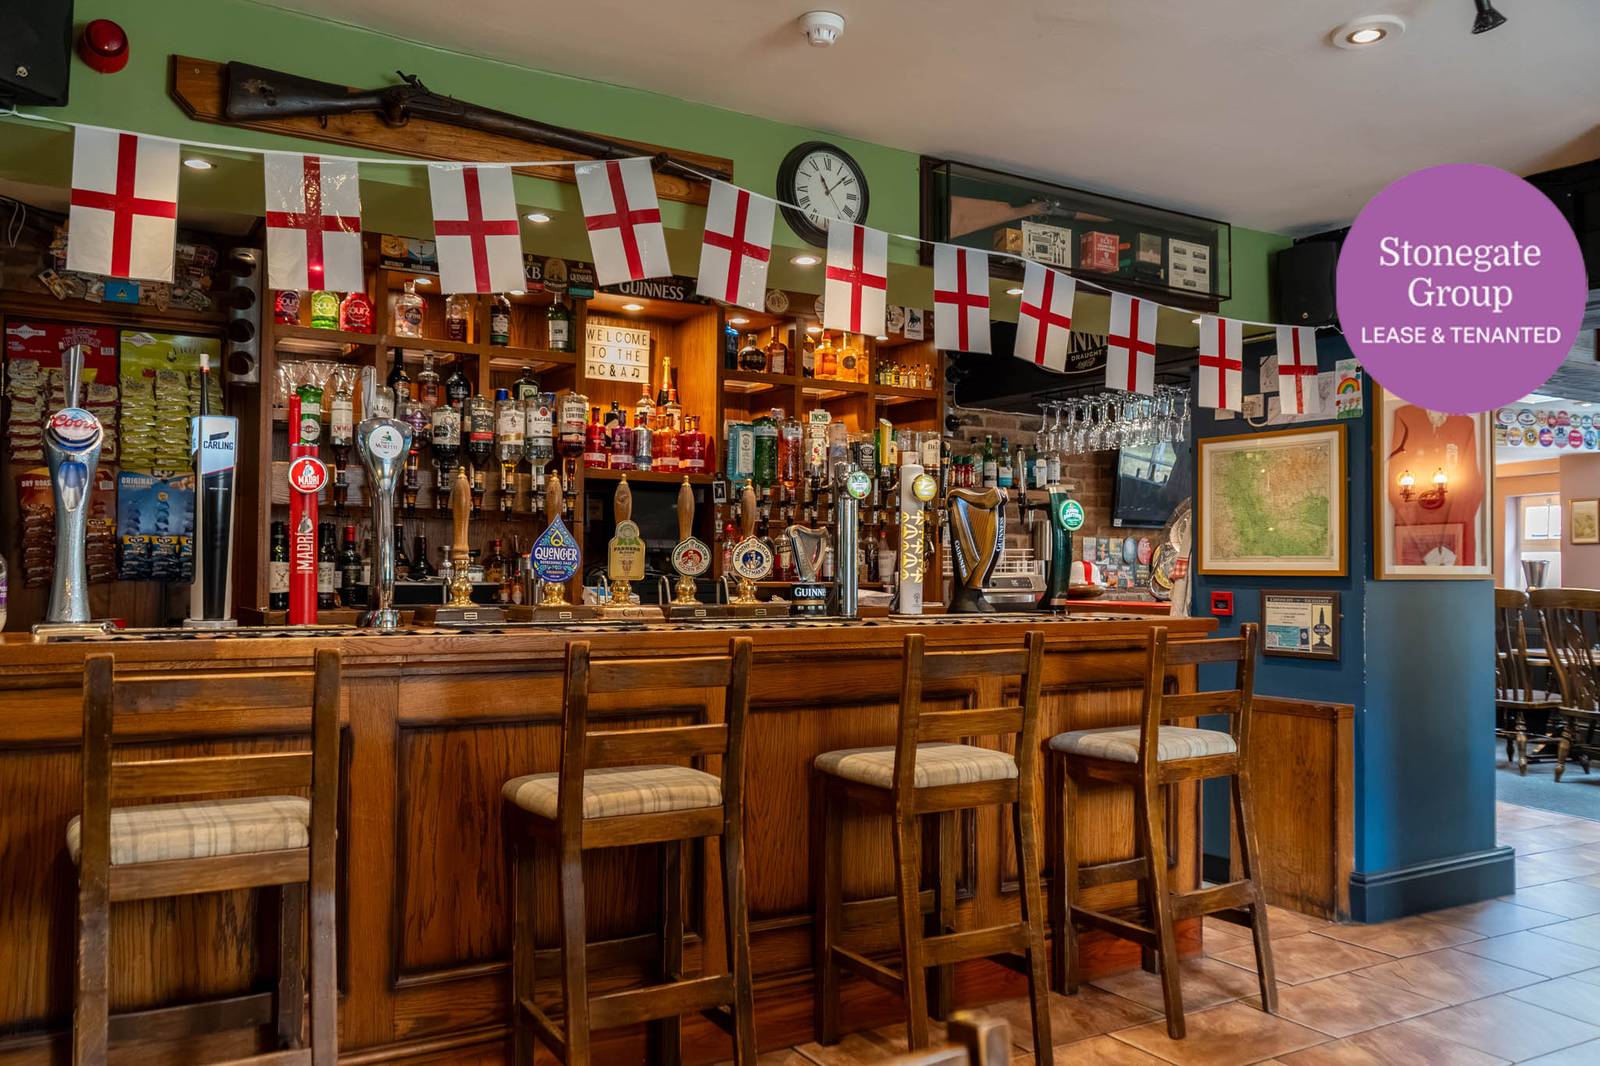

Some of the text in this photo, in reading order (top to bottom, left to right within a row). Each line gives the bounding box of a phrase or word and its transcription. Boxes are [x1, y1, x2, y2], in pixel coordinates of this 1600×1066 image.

[618, 281, 685, 300] GUINNESS
[586, 329, 647, 346] WELCOME
[592, 346, 641, 362] TO THE
[1071, 348, 1103, 362] DRAUGHT
[49, 414, 100, 430] Coors
[203, 440, 234, 451] CARLING
[121, 476, 153, 486] ORIGINAL
[995, 516, 1005, 553] GUINNESS
[734, 543, 750, 562] TIMOTHY
[954, 539, 969, 578] GUINNESS
